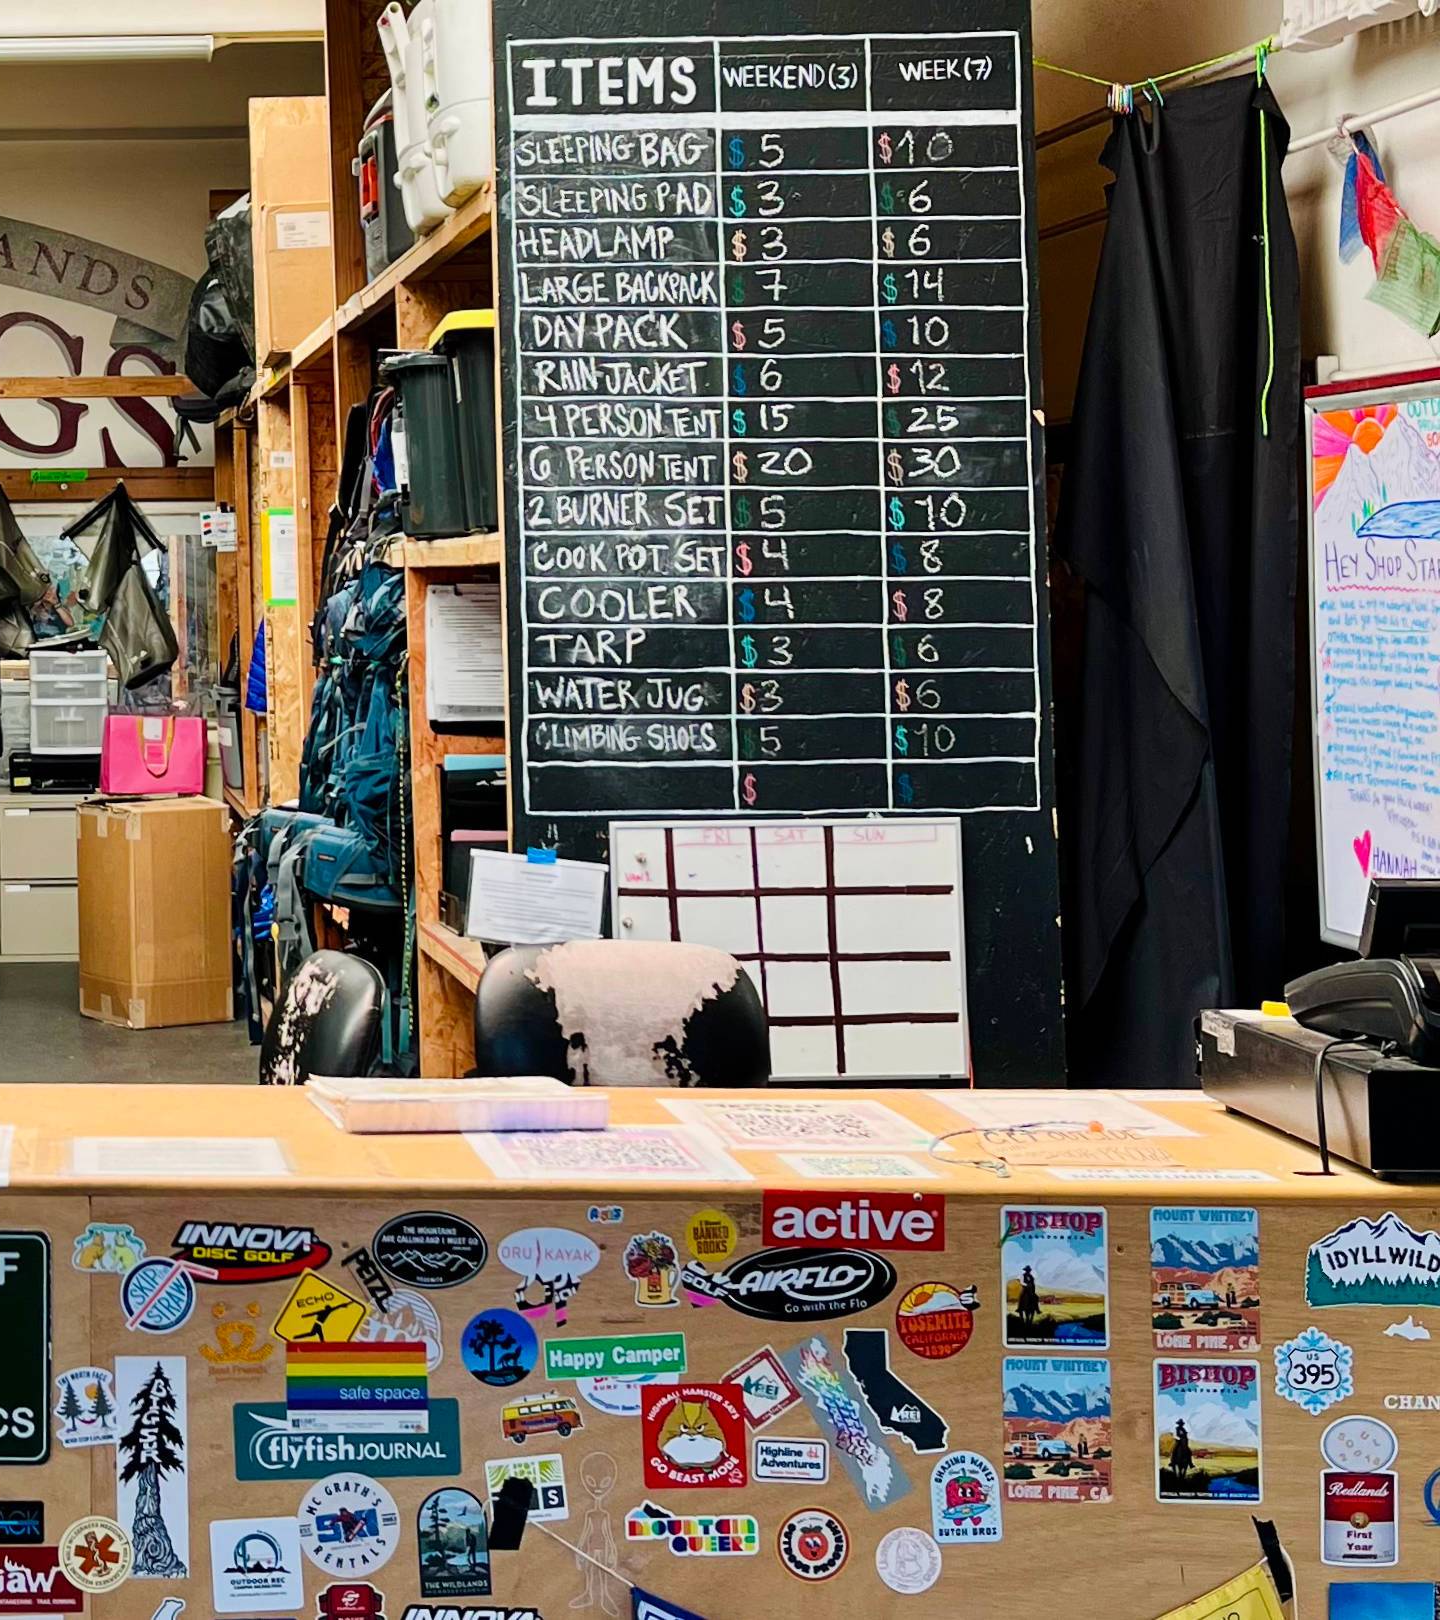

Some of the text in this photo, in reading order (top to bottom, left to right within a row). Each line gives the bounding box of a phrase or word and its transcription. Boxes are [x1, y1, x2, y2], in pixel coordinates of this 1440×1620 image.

[522, 57, 698, 107] ITEMS
[516, 133, 635, 167] SLEEPING
[641, 132, 709, 165] BAG
[517, 180, 713, 216] SLEEPING PAD
[518, 227, 674, 261] HEADLAMP
[521, 271, 609, 304] LARGE
[615, 270, 716, 304] BACKPACK
[532, 315, 593, 348] DAY
[596, 313, 689, 350] PACK
[536, 360, 606, 394] RAIN
[603, 360, 708, 394] JACKET
[535, 405, 558, 434] 4
[564, 405, 660, 439] PERSON
[663, 408, 722, 440] TENT
[528, 446, 552, 481] 6
[565, 448, 654, 482] PERSON
[660, 454, 717, 482] TENT
[529, 492, 722, 526] 2 BURNER SET
[533, 540, 725, 575] COOK POT SET
[537, 585, 697, 623] COOLER
[536, 628, 647, 666] TARP
[535, 676, 704, 712] WATER JUG
[535, 722, 641, 753] CLIMBING
[647, 721, 717, 752] SHOES
[773, 828, 808, 842] SAT
[852, 828, 886, 842] SUN
[772, 1200, 934, 1242] active
[1007, 1211, 1103, 1236] BISHOP
[1153, 1209, 1196, 1222] MOUNT
[178, 1223, 312, 1251] INNOVA
[193, 1247, 294, 1263] DISC GOLF
[502, 1248, 592, 1262] ORU KAYAK
[1327, 1246, 1440, 1273] IDYLLWILD
[296, 1291, 334, 1308] ECHO
[804, 1299, 868, 1311] with the Flo
[899, 1311, 972, 1332] YOSEMITE
[1157, 1333, 1193, 1348] LONE
[550, 1350, 604, 1371] Happy
[612, 1345, 680, 1365] Camper
[1160, 1364, 1256, 1389] BISHOP
[1293, 1364, 1335, 1385] 395
[339, 1386, 424, 1403] safe space.
[760, 1445, 803, 1457] Highline
[760, 1458, 821, 1469] Adventures
[1008, 1484, 1044, 1499] LONE
[1327, 1481, 1389, 1497] Redlands
[671, 1535, 755, 1552] QUEERS
[1346, 1531, 1372, 1539] First
[1347, 1542, 1373, 1551] Year
[443, 1579, 488, 1589] WILDLANDS
